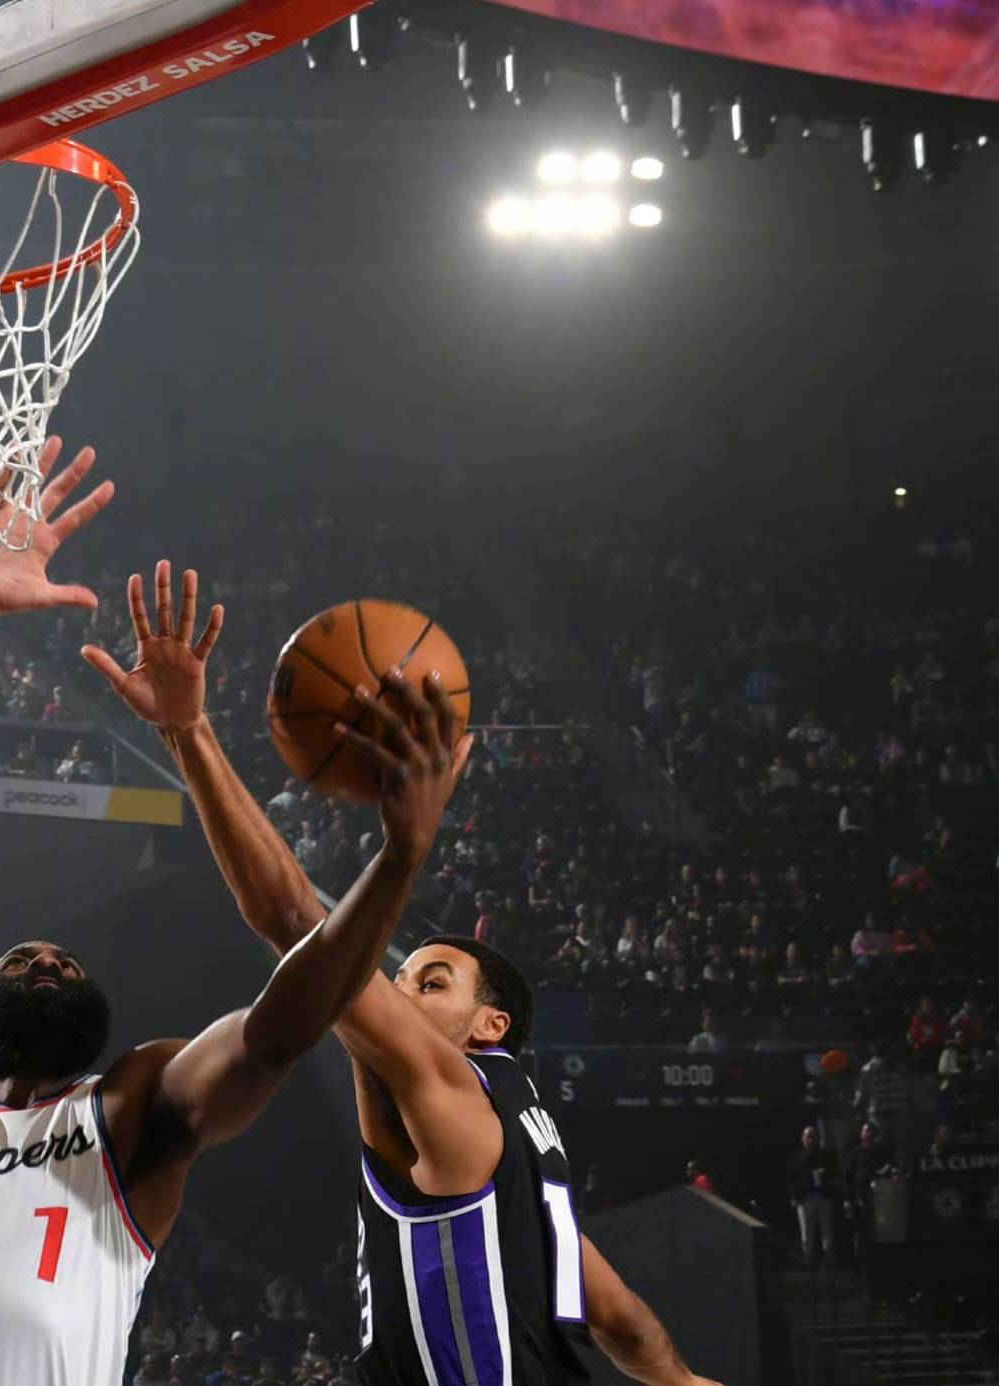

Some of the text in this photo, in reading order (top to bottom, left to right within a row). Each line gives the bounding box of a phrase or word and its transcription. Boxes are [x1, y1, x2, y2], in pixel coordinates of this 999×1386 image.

[39, 31, 276, 127] HERDEZ SALSA
[5, 790, 80, 810] peacock
[661, 1064, 714, 1086] 10:00
[34, 1206, 69, 1283] 1
